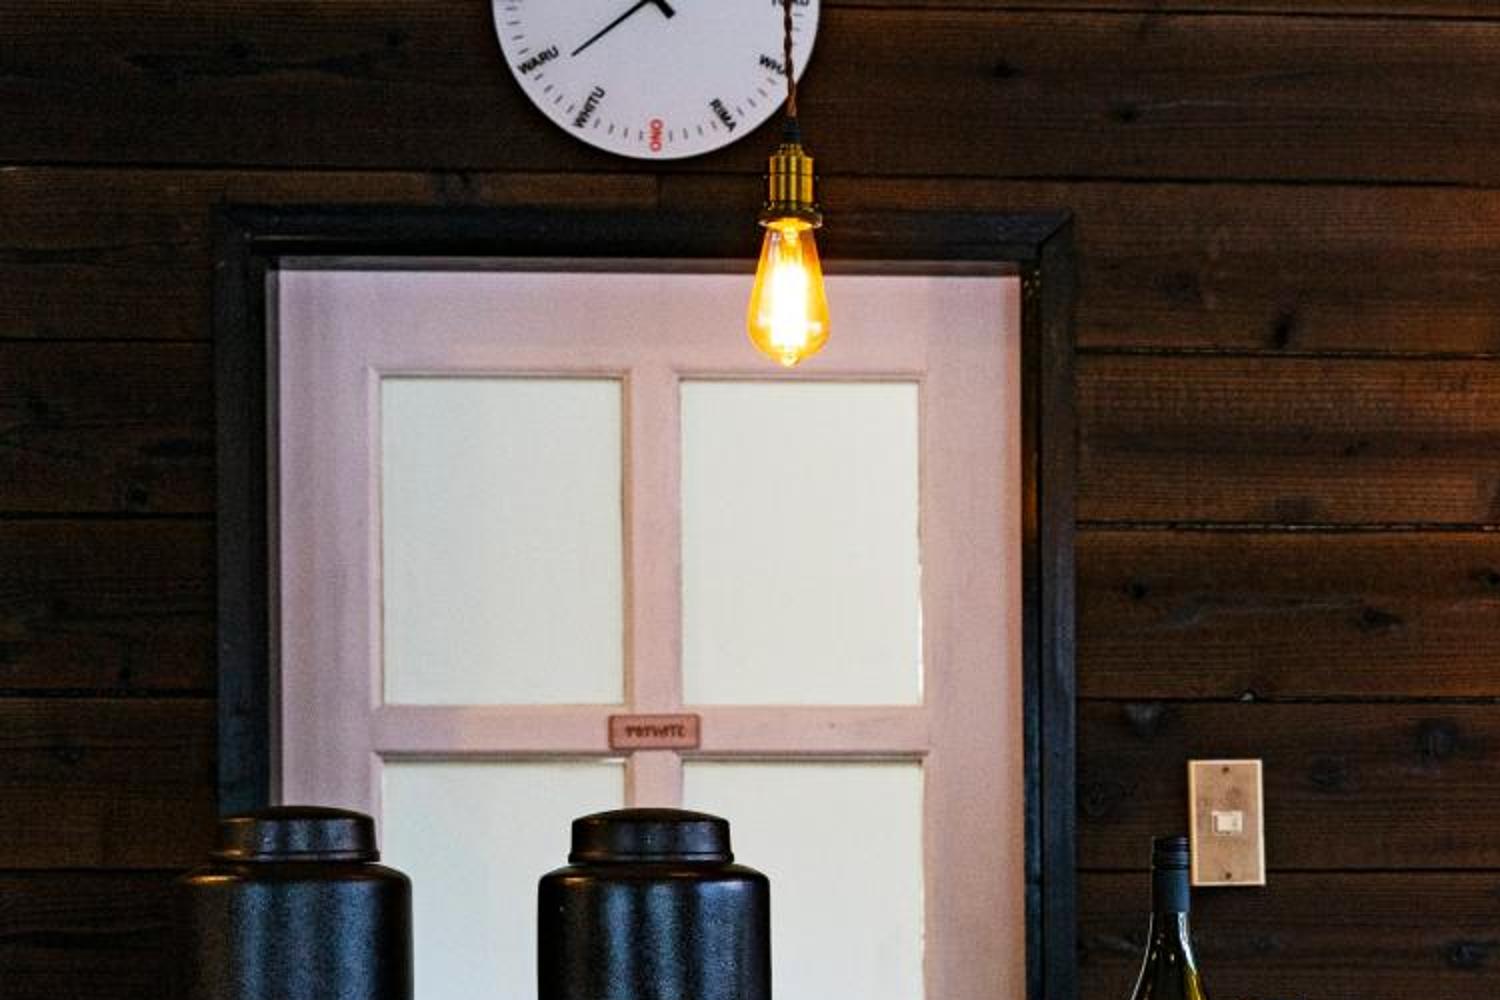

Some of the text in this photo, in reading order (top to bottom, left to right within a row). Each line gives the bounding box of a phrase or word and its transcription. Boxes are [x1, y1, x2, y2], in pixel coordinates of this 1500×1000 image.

[518, 45, 561, 76] WARU
[759, 54, 786, 75] WH
[574, 86, 606, 128] WHITU
[709, 98, 738, 132] RIMA
[650, 118, 664, 152] ONO
